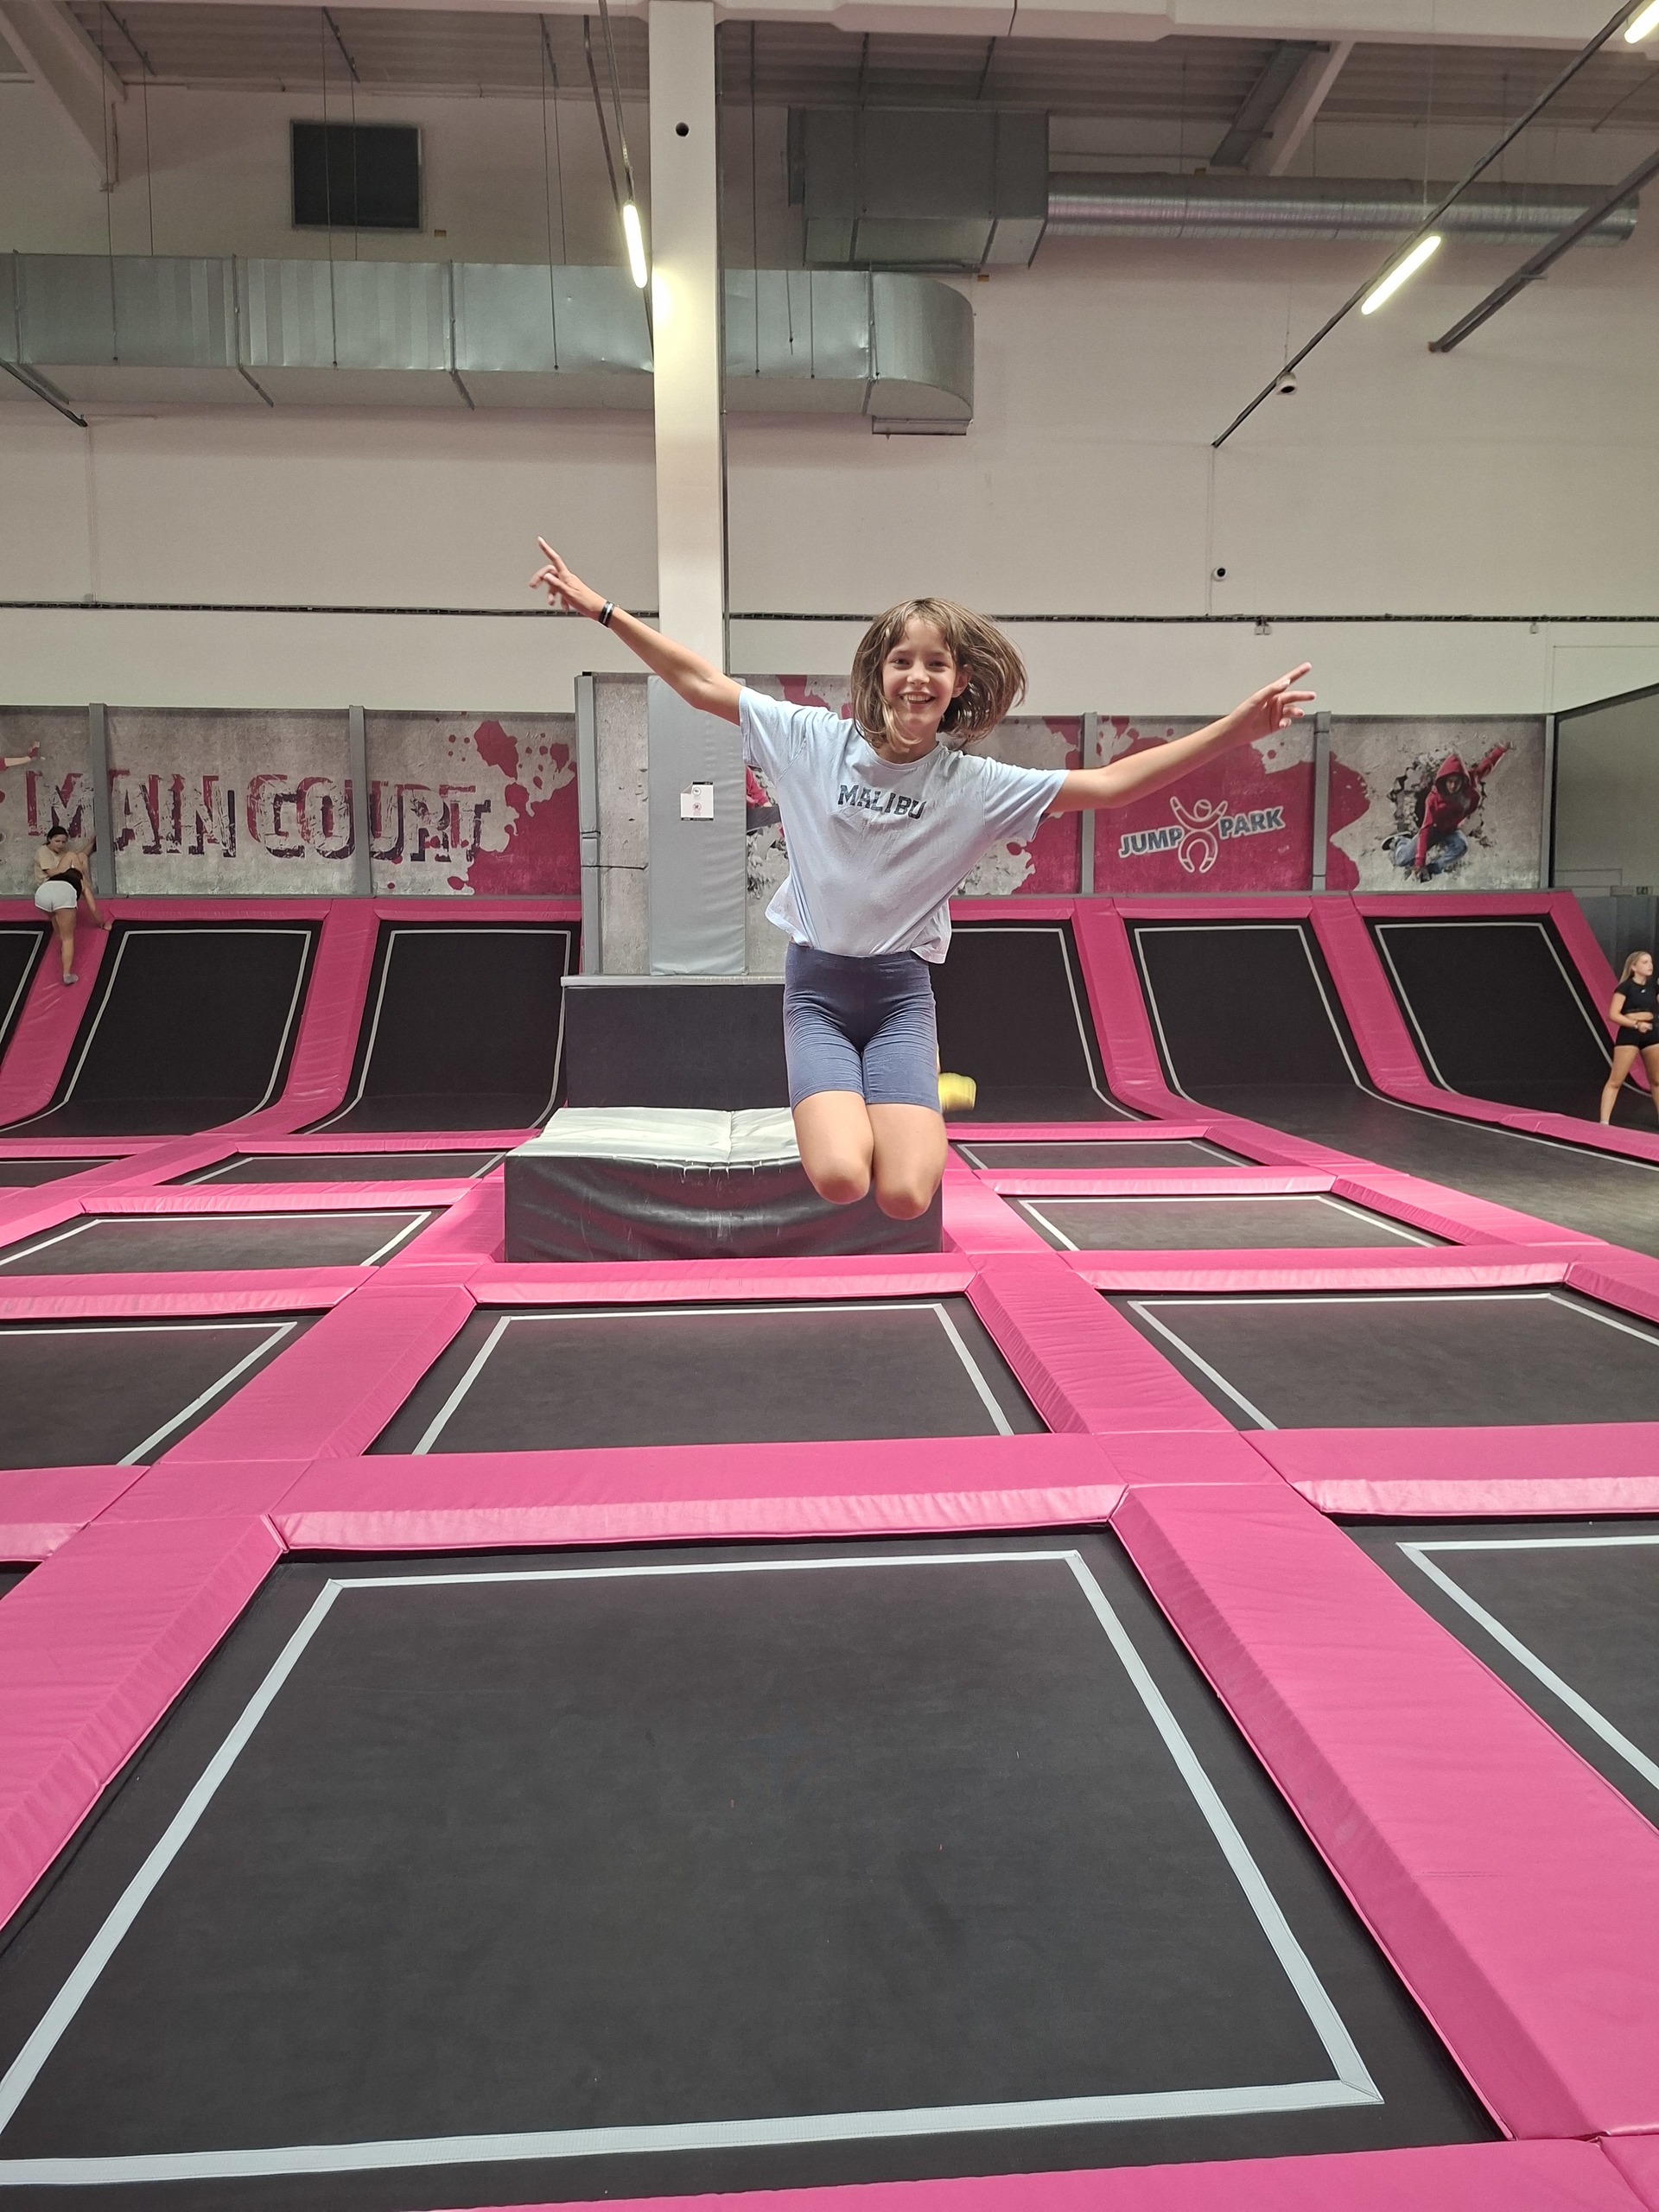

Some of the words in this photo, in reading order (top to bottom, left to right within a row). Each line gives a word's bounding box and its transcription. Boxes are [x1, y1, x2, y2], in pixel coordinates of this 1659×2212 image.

[25, 769, 238, 858] MAIN
[245, 772, 492, 863] COURT
[837, 784, 927, 820] MALIBU
[1119, 825, 1185, 858] JUMP
[1217, 805, 1286, 839] PARK
